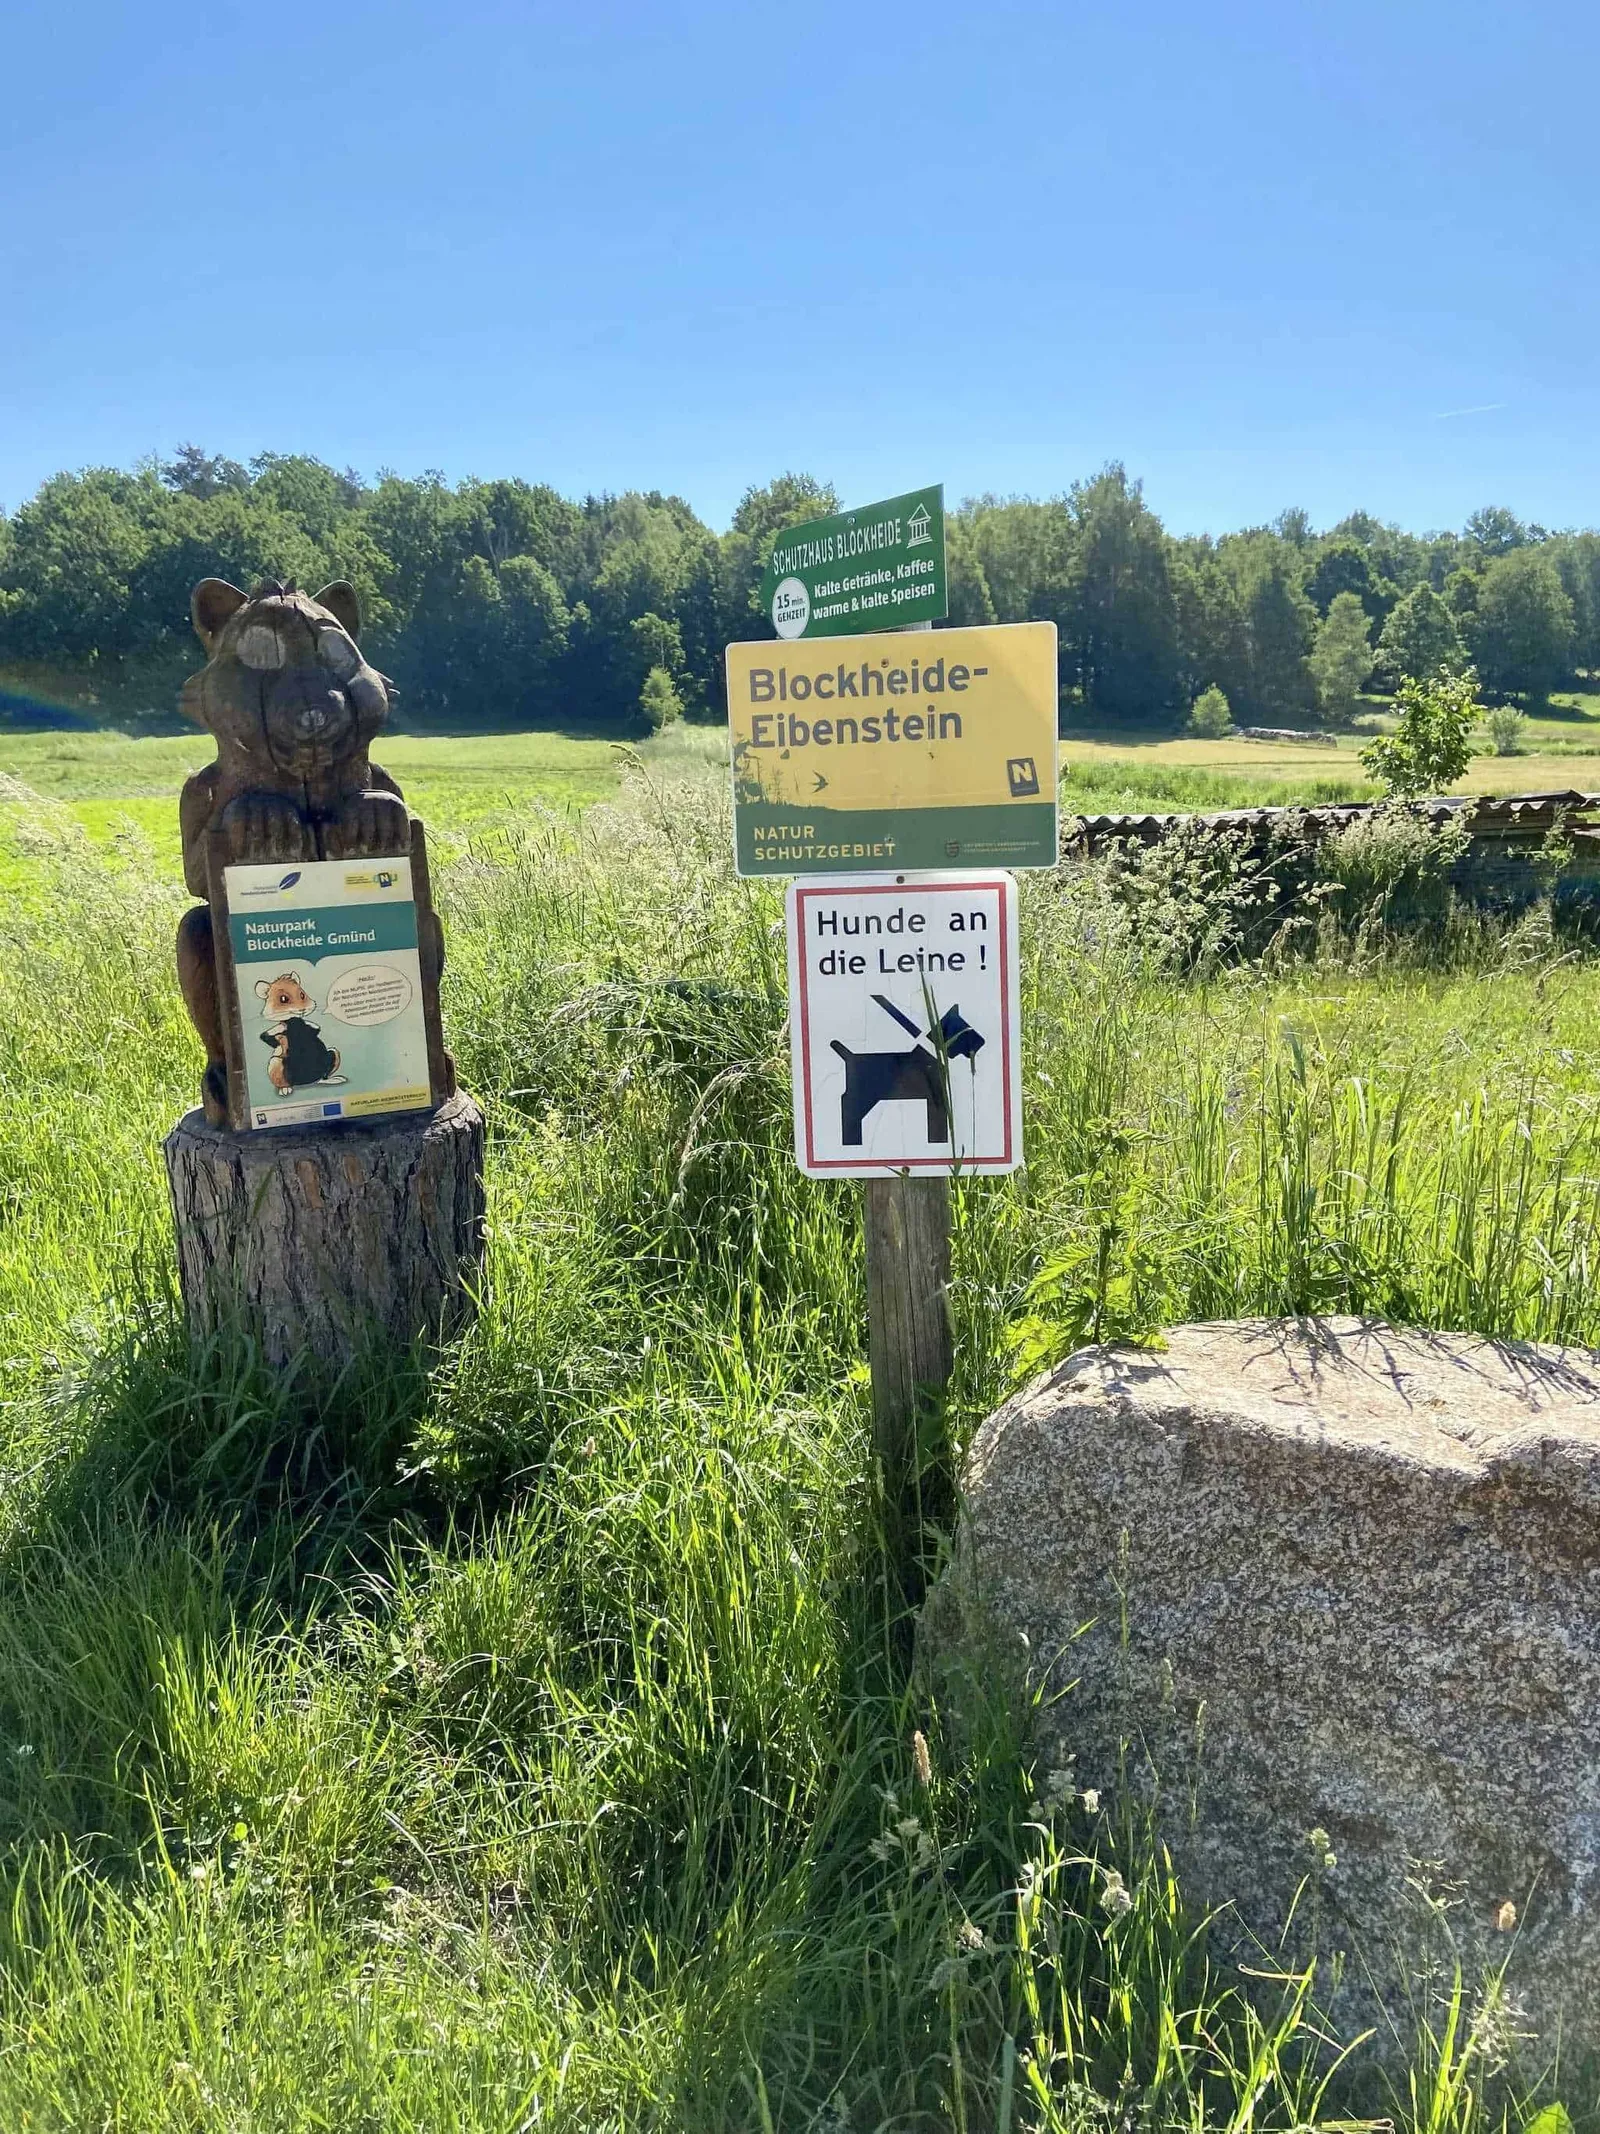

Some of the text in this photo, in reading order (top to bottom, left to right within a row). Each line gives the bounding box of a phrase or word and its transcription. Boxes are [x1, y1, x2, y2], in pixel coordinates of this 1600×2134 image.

[773, 518, 902, 576] SCHUTZHAUS BLOCKHEIDE
[814, 559, 934, 598] Kalte Getränke, Kaffee
[776, 593, 790, 610] 15
[777, 607, 806, 623] GEHZEIT
[813, 582, 935, 620] warme & kalte Speisen
[749, 657, 989, 703] Blockheide-
[751, 704, 963, 749] Eibenstein
[753, 825, 815, 841] NATUR
[754, 842, 896, 861] SCHUTZGEBIET
[245, 918, 317, 935] Naturpark
[817, 907, 988, 936] Hunde an
[246, 929, 376, 951] Blockheide Gmünd
[818, 944, 987, 976] die Leine !
